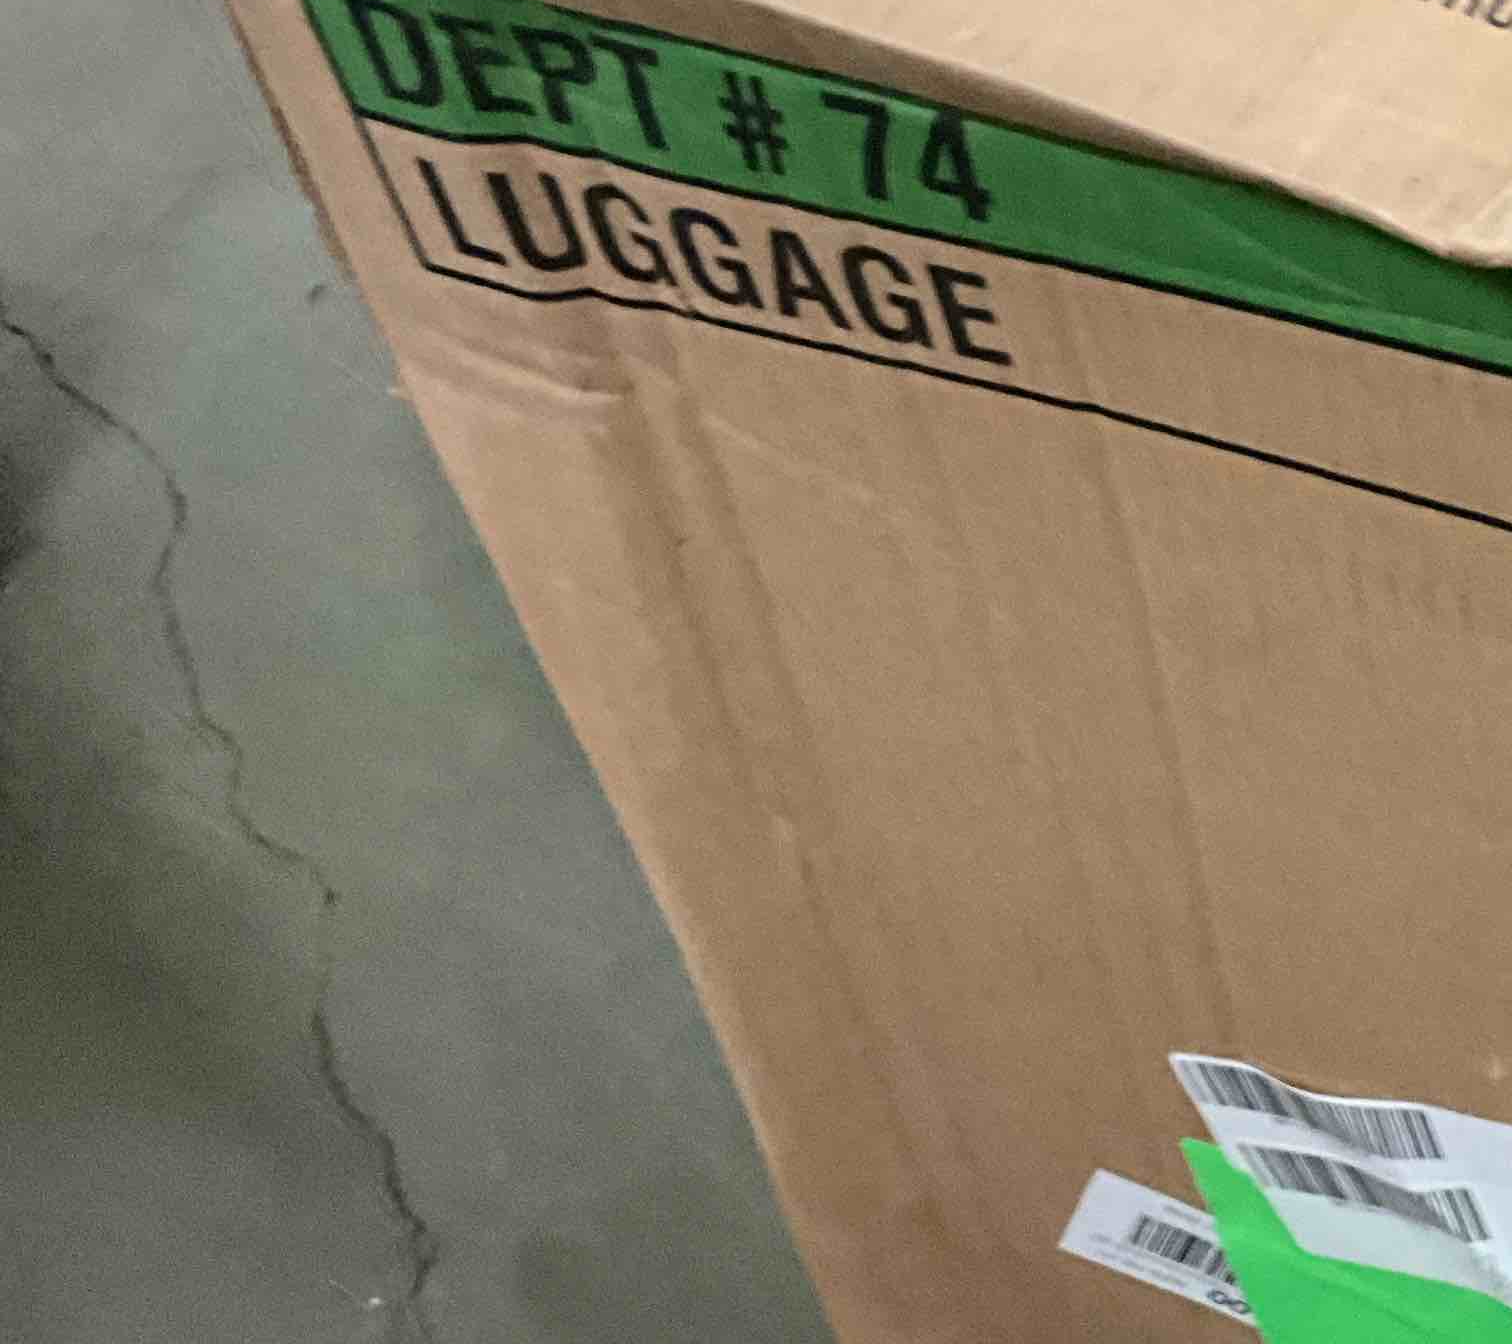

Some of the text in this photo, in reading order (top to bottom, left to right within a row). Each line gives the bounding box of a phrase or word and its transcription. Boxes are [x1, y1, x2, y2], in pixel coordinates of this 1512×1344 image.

[717, 70, 790, 176] #
[821, 90, 993, 222] 74
[416, 158, 1012, 368] LUGGAGE
